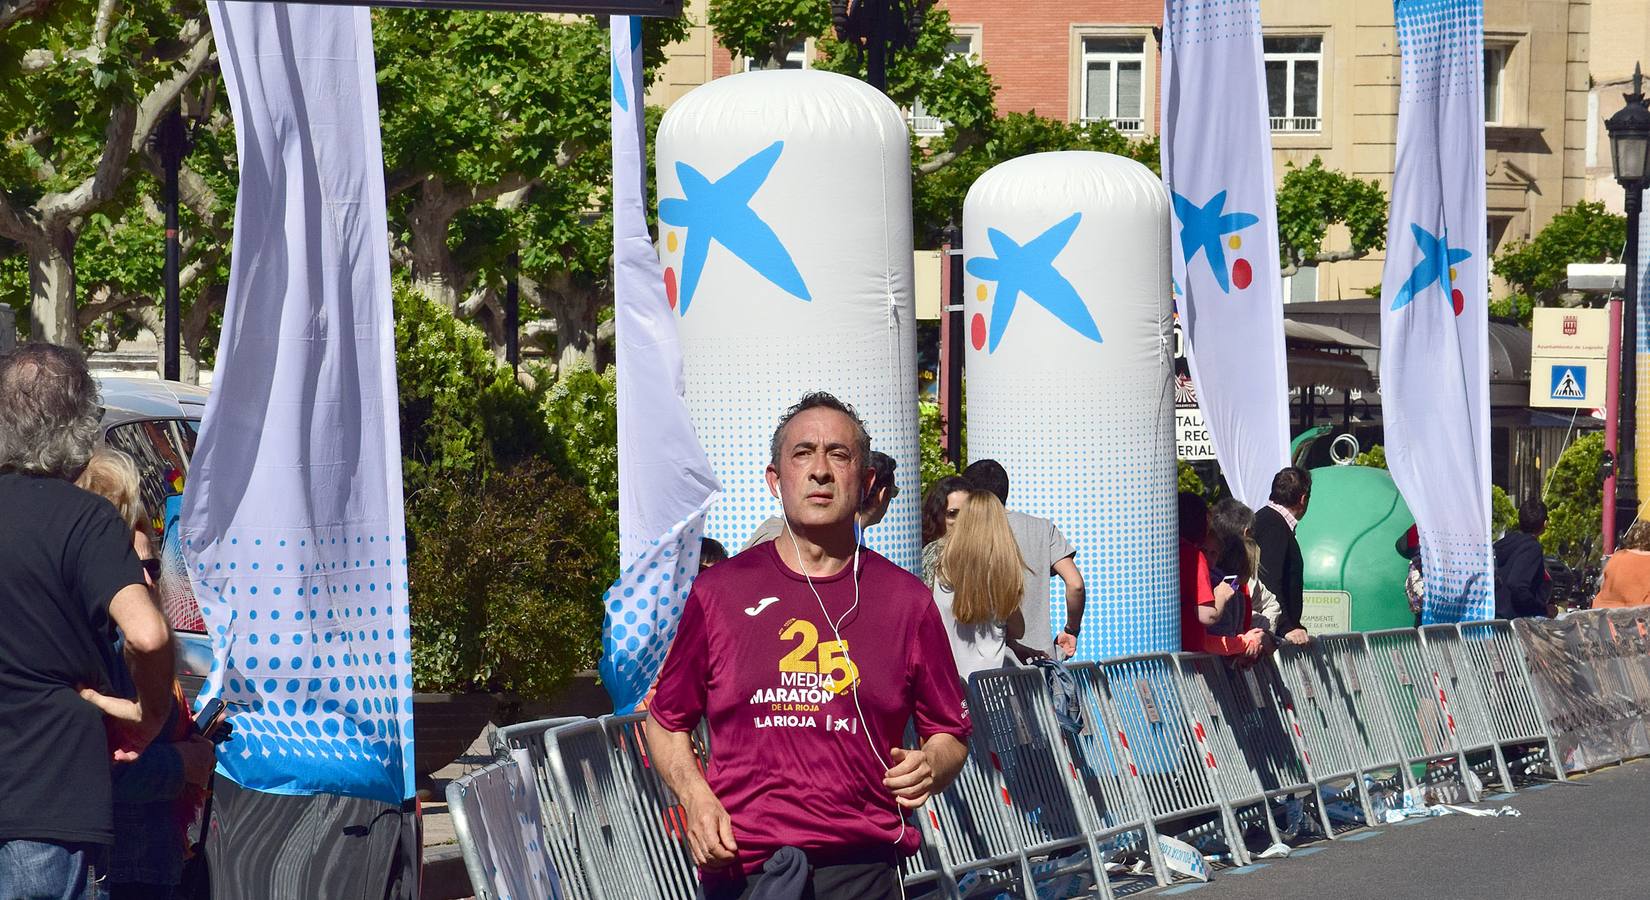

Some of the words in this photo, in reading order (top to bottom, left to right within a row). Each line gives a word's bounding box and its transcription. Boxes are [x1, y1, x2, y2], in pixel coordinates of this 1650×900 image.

[1178, 445, 1215, 456] ERIAL
[1303, 596, 1341, 604] VIDRIO
[779, 619, 859, 693] 25
[781, 672, 835, 688] MEDIA
[750, 686, 834, 703] MARATÓN
